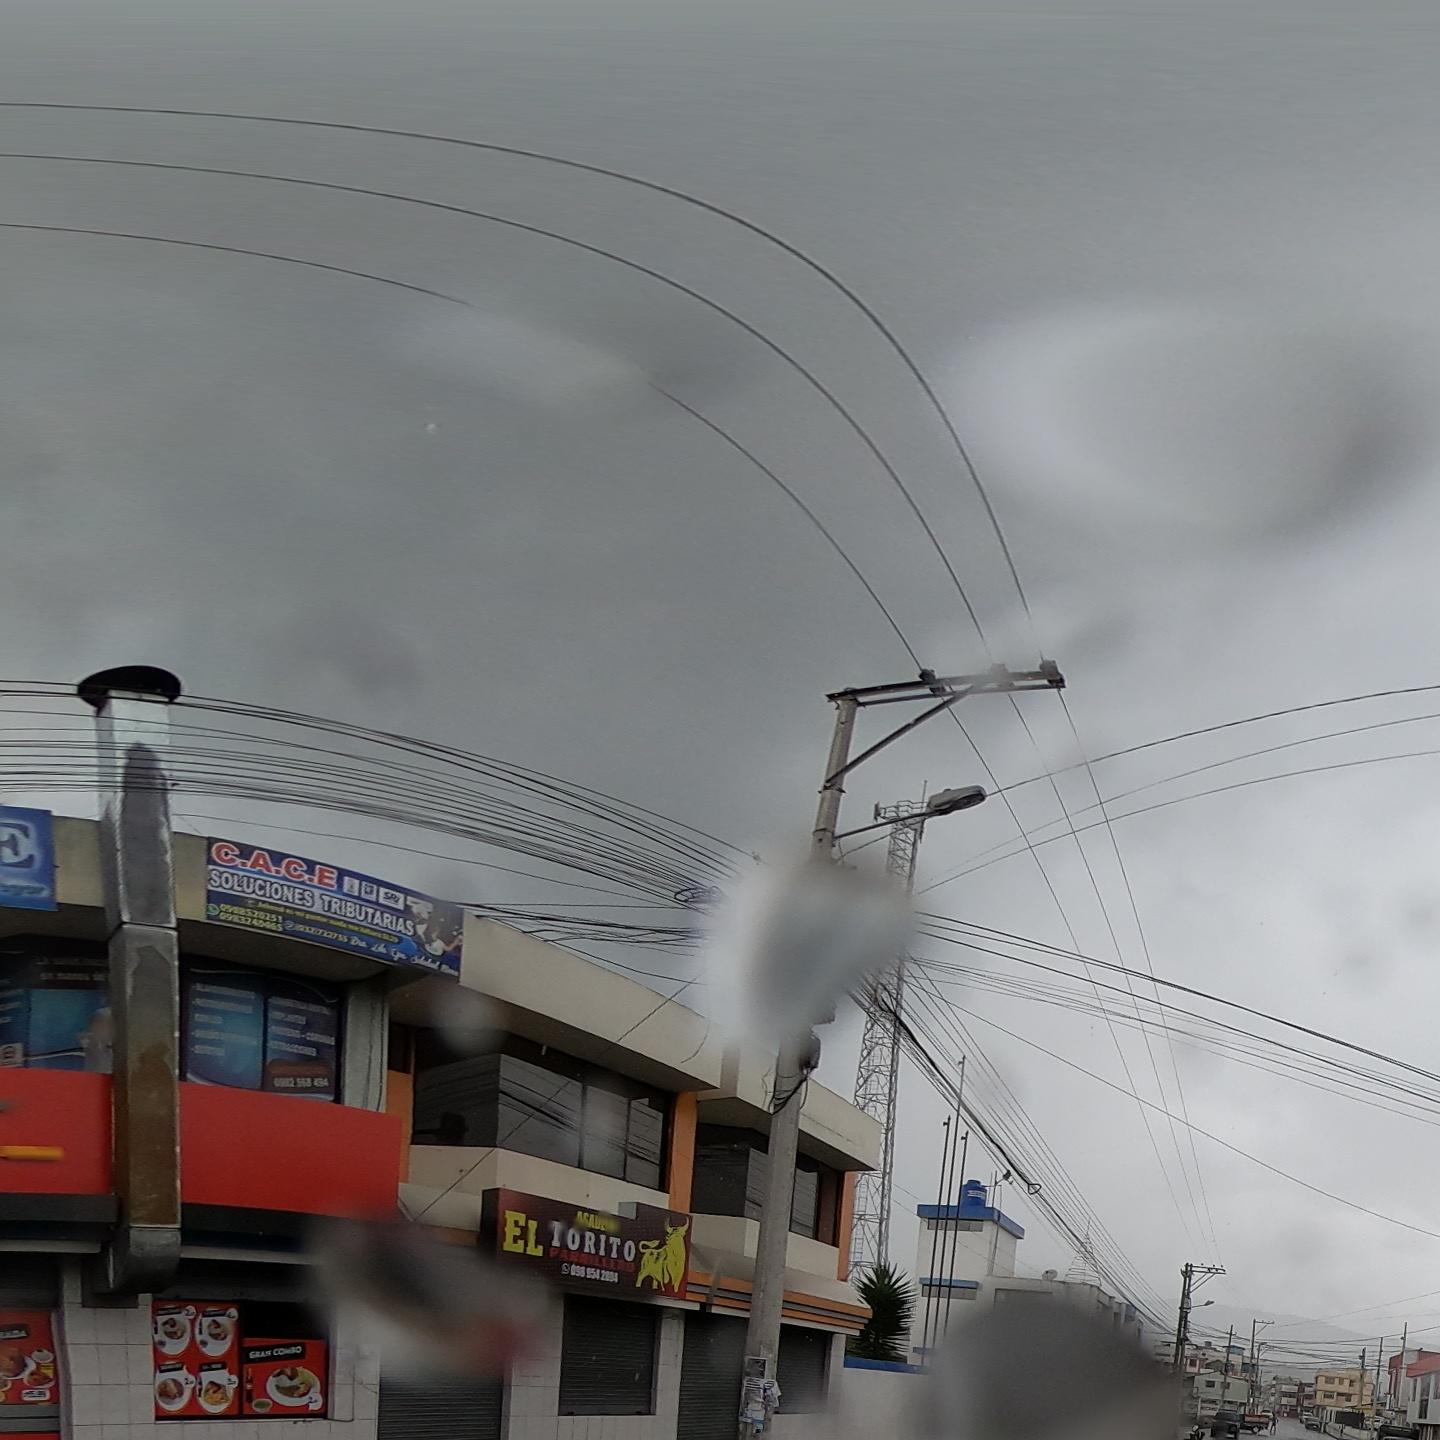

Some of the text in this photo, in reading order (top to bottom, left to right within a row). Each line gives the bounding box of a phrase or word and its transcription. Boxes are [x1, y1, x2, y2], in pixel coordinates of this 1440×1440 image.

[210, 869, 314, 908] SOLUCIONES
[320, 894, 416, 936] TRIBUTARIAS
[503, 1209, 637, 1262] EL TORITO
